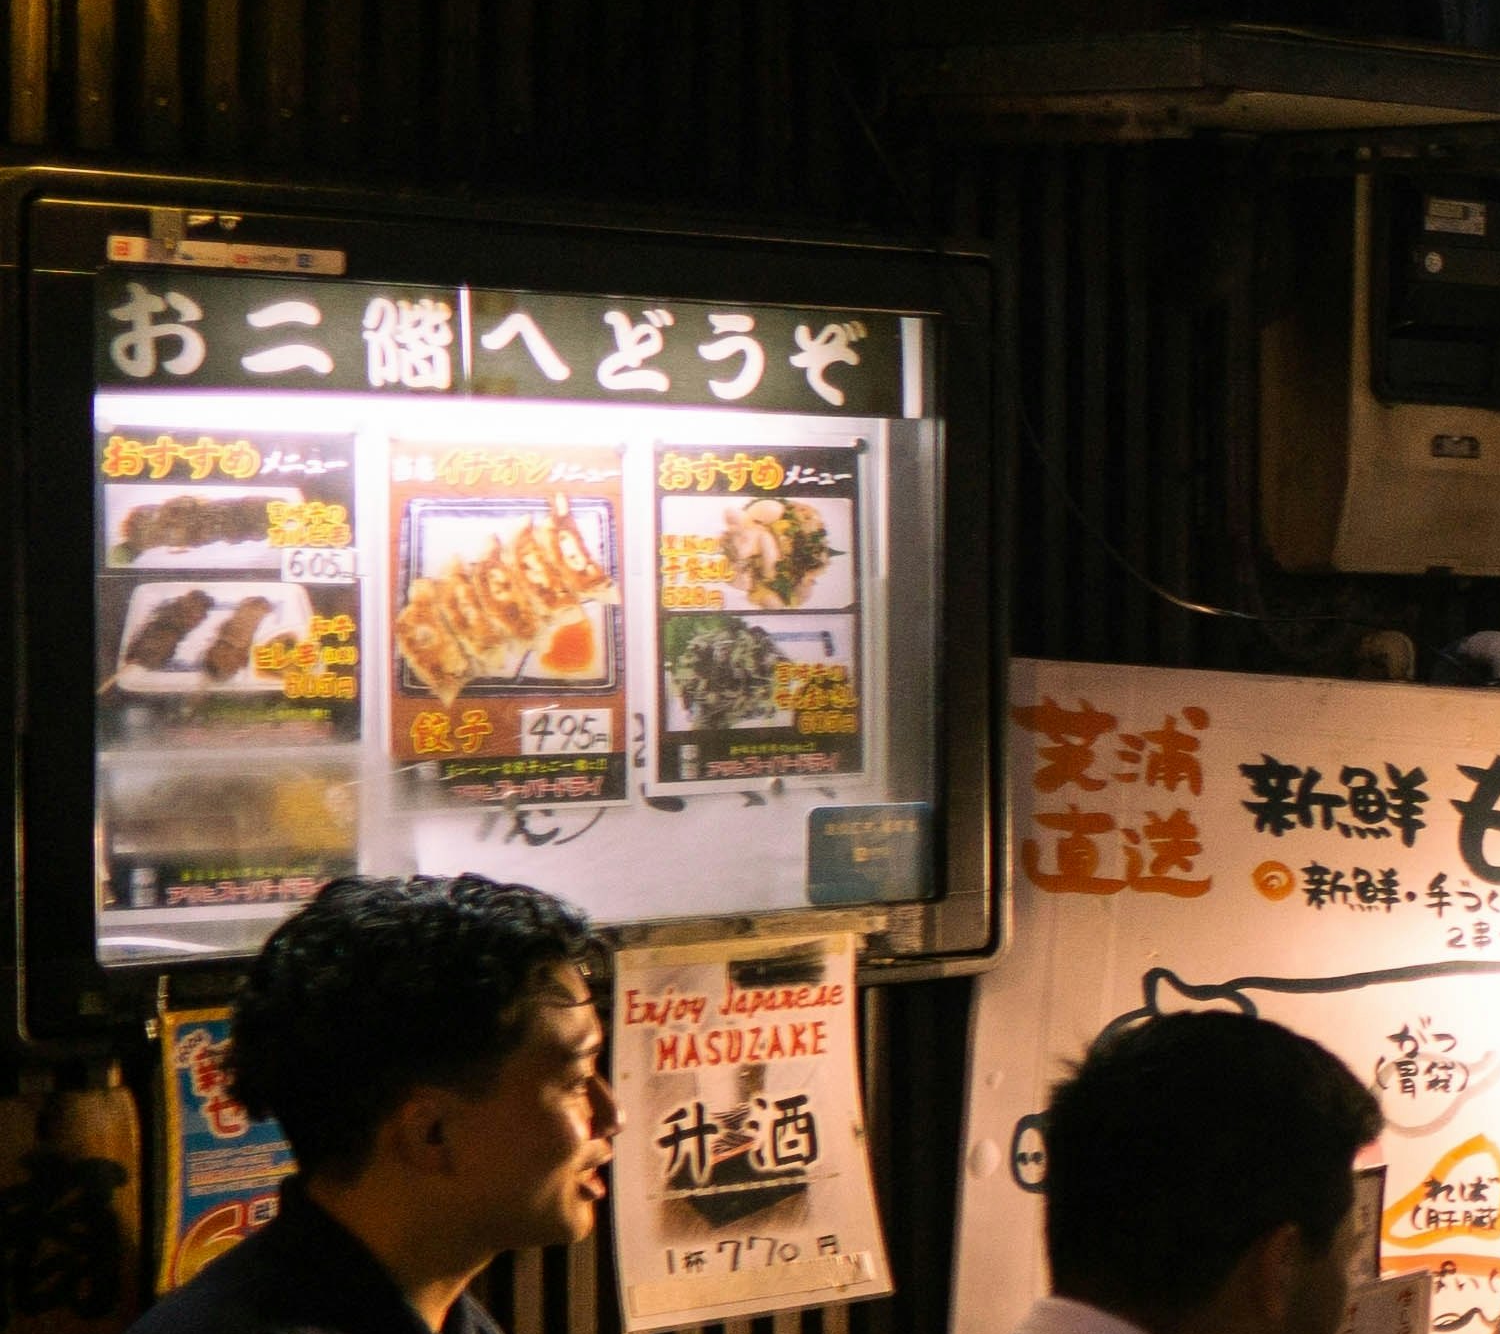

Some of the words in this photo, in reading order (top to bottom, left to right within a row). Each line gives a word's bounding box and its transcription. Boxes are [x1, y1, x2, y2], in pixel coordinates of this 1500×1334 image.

[108, 282, 870, 405] お二階へどうぞ
[1012, 698, 1212, 795] 芝浦
[1022, 804, 1212, 900] 直送
[625, 989, 705, 1026] Enjoy
[719, 981, 846, 1021] Japanese
[656, 1021, 829, 1071] MASUZAKE
[658, 1094, 820, 1183] 升酒
